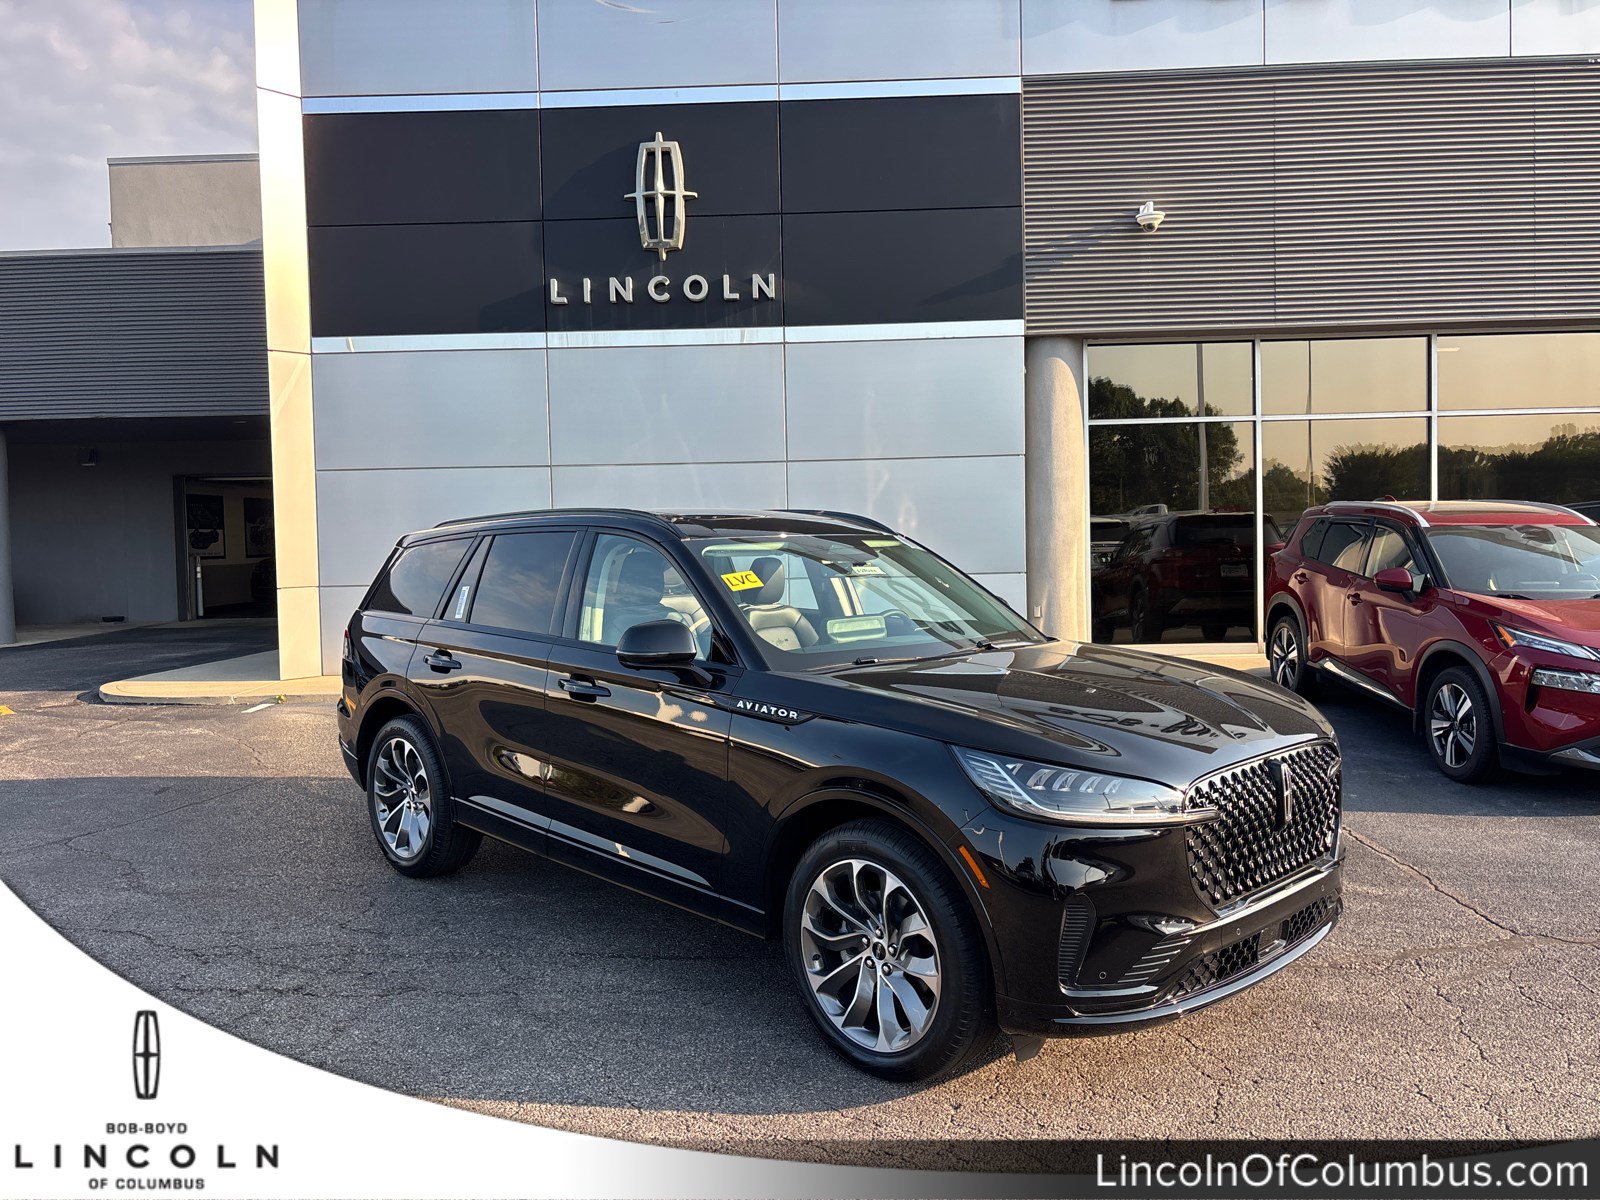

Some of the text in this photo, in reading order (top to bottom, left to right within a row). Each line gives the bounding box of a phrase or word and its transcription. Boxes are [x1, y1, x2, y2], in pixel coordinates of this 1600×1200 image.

[550, 273, 776, 304] LINCOLN
[725, 573, 758, 587] LVC
[736, 700, 798, 719] AVIATOR
